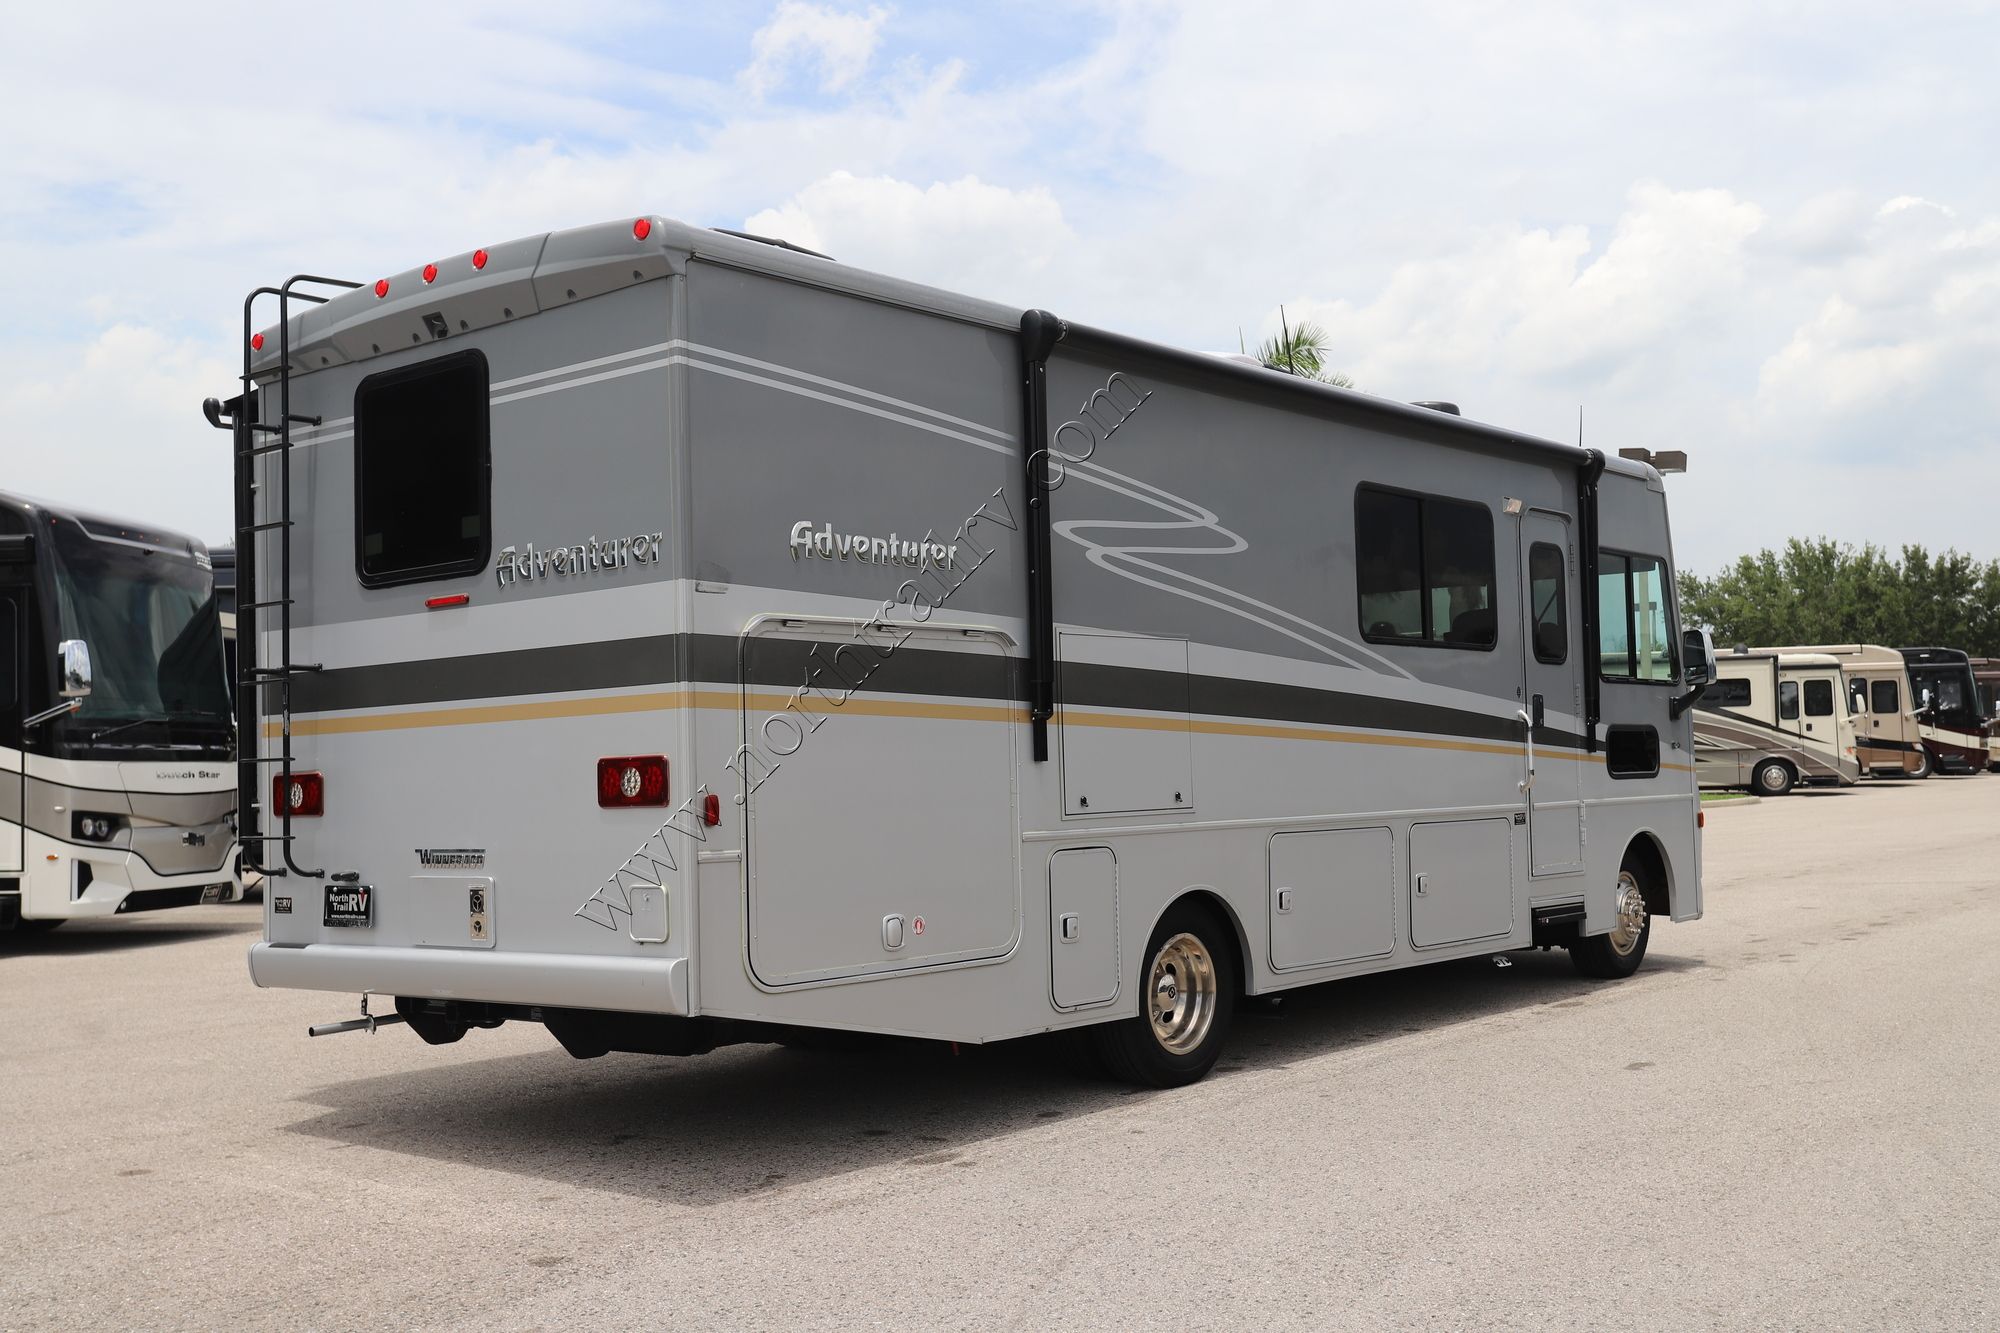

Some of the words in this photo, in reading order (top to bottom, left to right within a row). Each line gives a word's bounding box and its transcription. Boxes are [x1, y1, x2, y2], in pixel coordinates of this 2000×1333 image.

[789, 520, 958, 571] Adventurer
[496, 531, 663, 590] Adventurer
[198, 770, 221, 779] Star
[329, 893, 349, 902] North
[348, 893, 368, 912] RV
[333, 902, 349, 911] Trail
